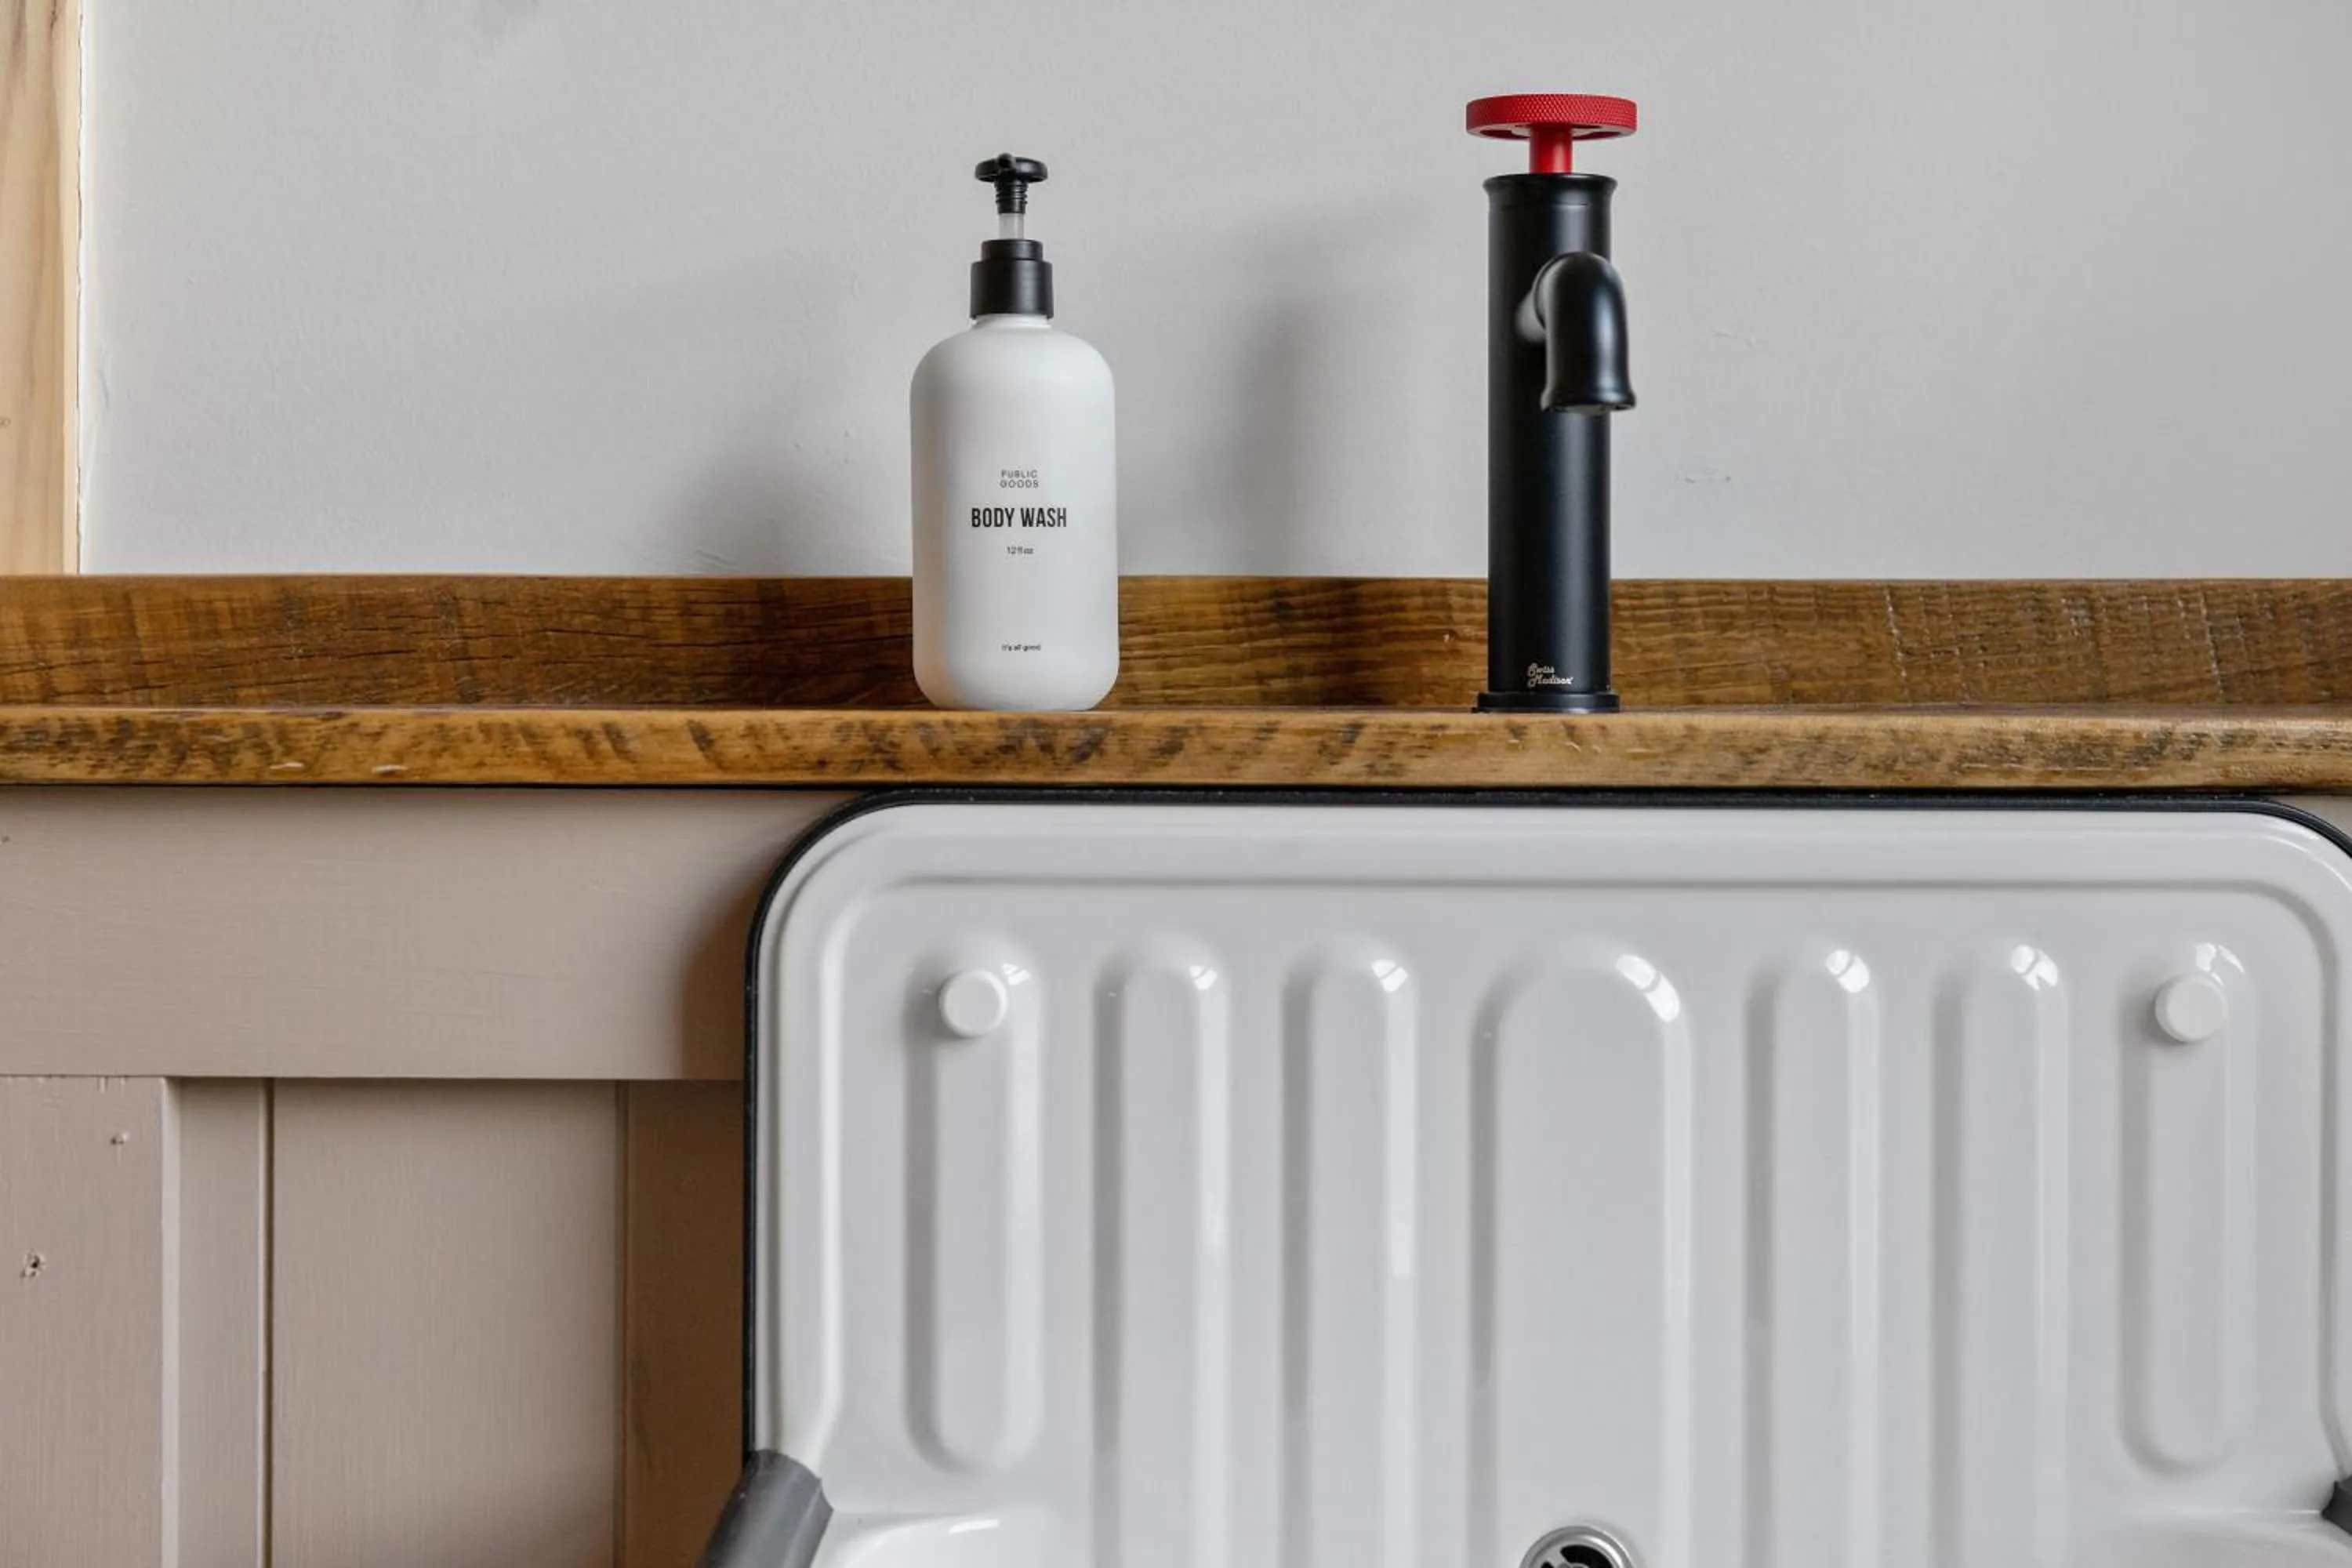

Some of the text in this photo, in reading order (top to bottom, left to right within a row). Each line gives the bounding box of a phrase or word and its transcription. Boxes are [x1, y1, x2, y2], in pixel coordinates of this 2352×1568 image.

[1001, 470, 1038, 478] PUBLIC
[1000, 479, 1039, 488] GOODS
[971, 507, 1067, 528] BODY WASH
